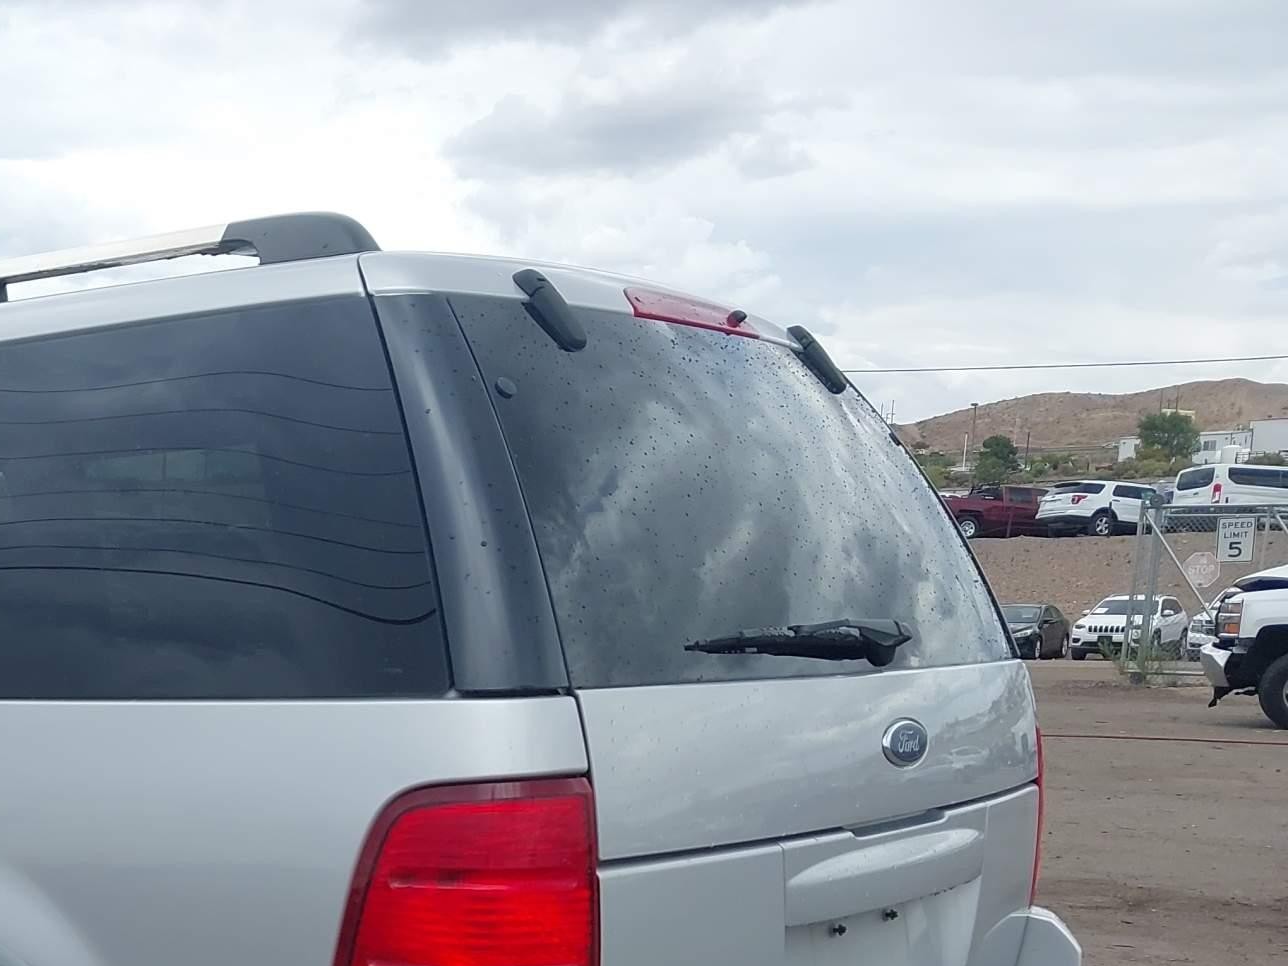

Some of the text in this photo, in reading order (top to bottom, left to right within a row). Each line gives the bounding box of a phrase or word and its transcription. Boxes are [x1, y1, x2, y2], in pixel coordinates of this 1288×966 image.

[1221, 521, 1253, 529] SPEED
[1224, 531, 1248, 539] LIMIT
[1228, 541, 1242, 558] 5
[1188, 565, 1215, 574] STOP
